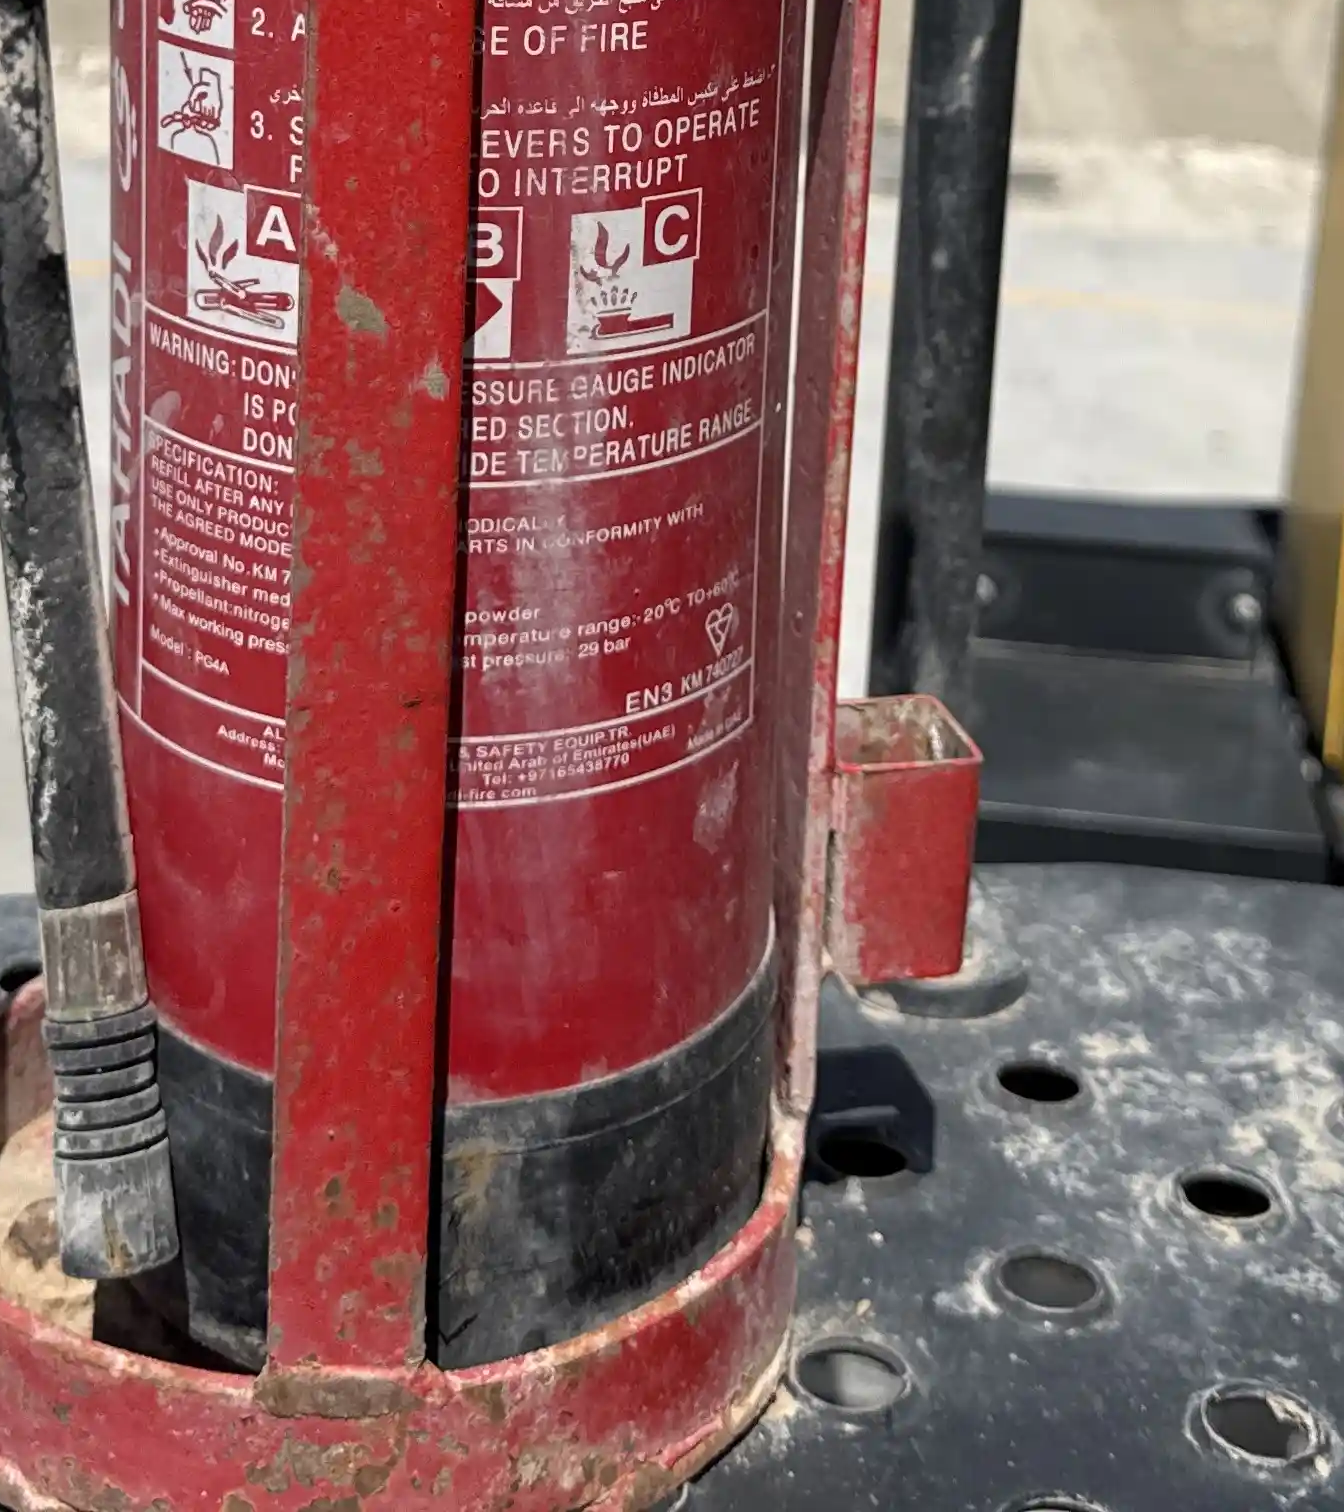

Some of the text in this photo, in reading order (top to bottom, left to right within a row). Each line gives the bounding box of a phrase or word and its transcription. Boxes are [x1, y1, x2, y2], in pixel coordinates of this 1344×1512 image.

[250, 6, 275, 39] 2.
[523, 25, 568, 56] OF
[580, 20, 649, 53] FIRE
[249, 110, 274, 142] 3.
[481, 126, 591, 159] EVERS
[604, 122, 643, 154] TO
[654, 98, 761, 149] OPERATE
[514, 152, 689, 198] INTERRUPT
[256, 204, 690, 268] A B C
[149, 322, 237, 378] WARNING:
[570, 365, 654, 402] GAUGE
[662, 332, 757, 386] INDICATOR
[243, 391, 264, 420] IS
[518, 404, 635, 441] SECTION.
[147, 429, 280, 496] SPECIFICATION:
[150, 454, 192, 489] REFILL
[195, 477, 244, 507] AFTER
[248, 495, 285, 516] ANY
[150, 476, 174, 501] USE
[175, 490, 214, 517] ONLY
[217, 505, 292, 538] PRODUC
[516, 539, 535, 552] IN
[667, 503, 705, 528] WITH
[150, 493, 174, 519] THE
[174, 510, 236, 543] AGREED
[158, 526, 218, 565] Approval
[159, 548, 249, 597] Extinguisher
[464, 606, 542, 625] powder
[149, 623, 184, 656] Model
[158, 593, 186, 621] Max
[187, 612, 244, 647] working
[578, 641, 599, 660] 29
[604, 637, 632, 654] bar
[680, 669, 703, 696] KM
[475, 741, 546, 758] SAFETY
[507, 754, 547, 771] Arab
[552, 753, 568, 766] of
